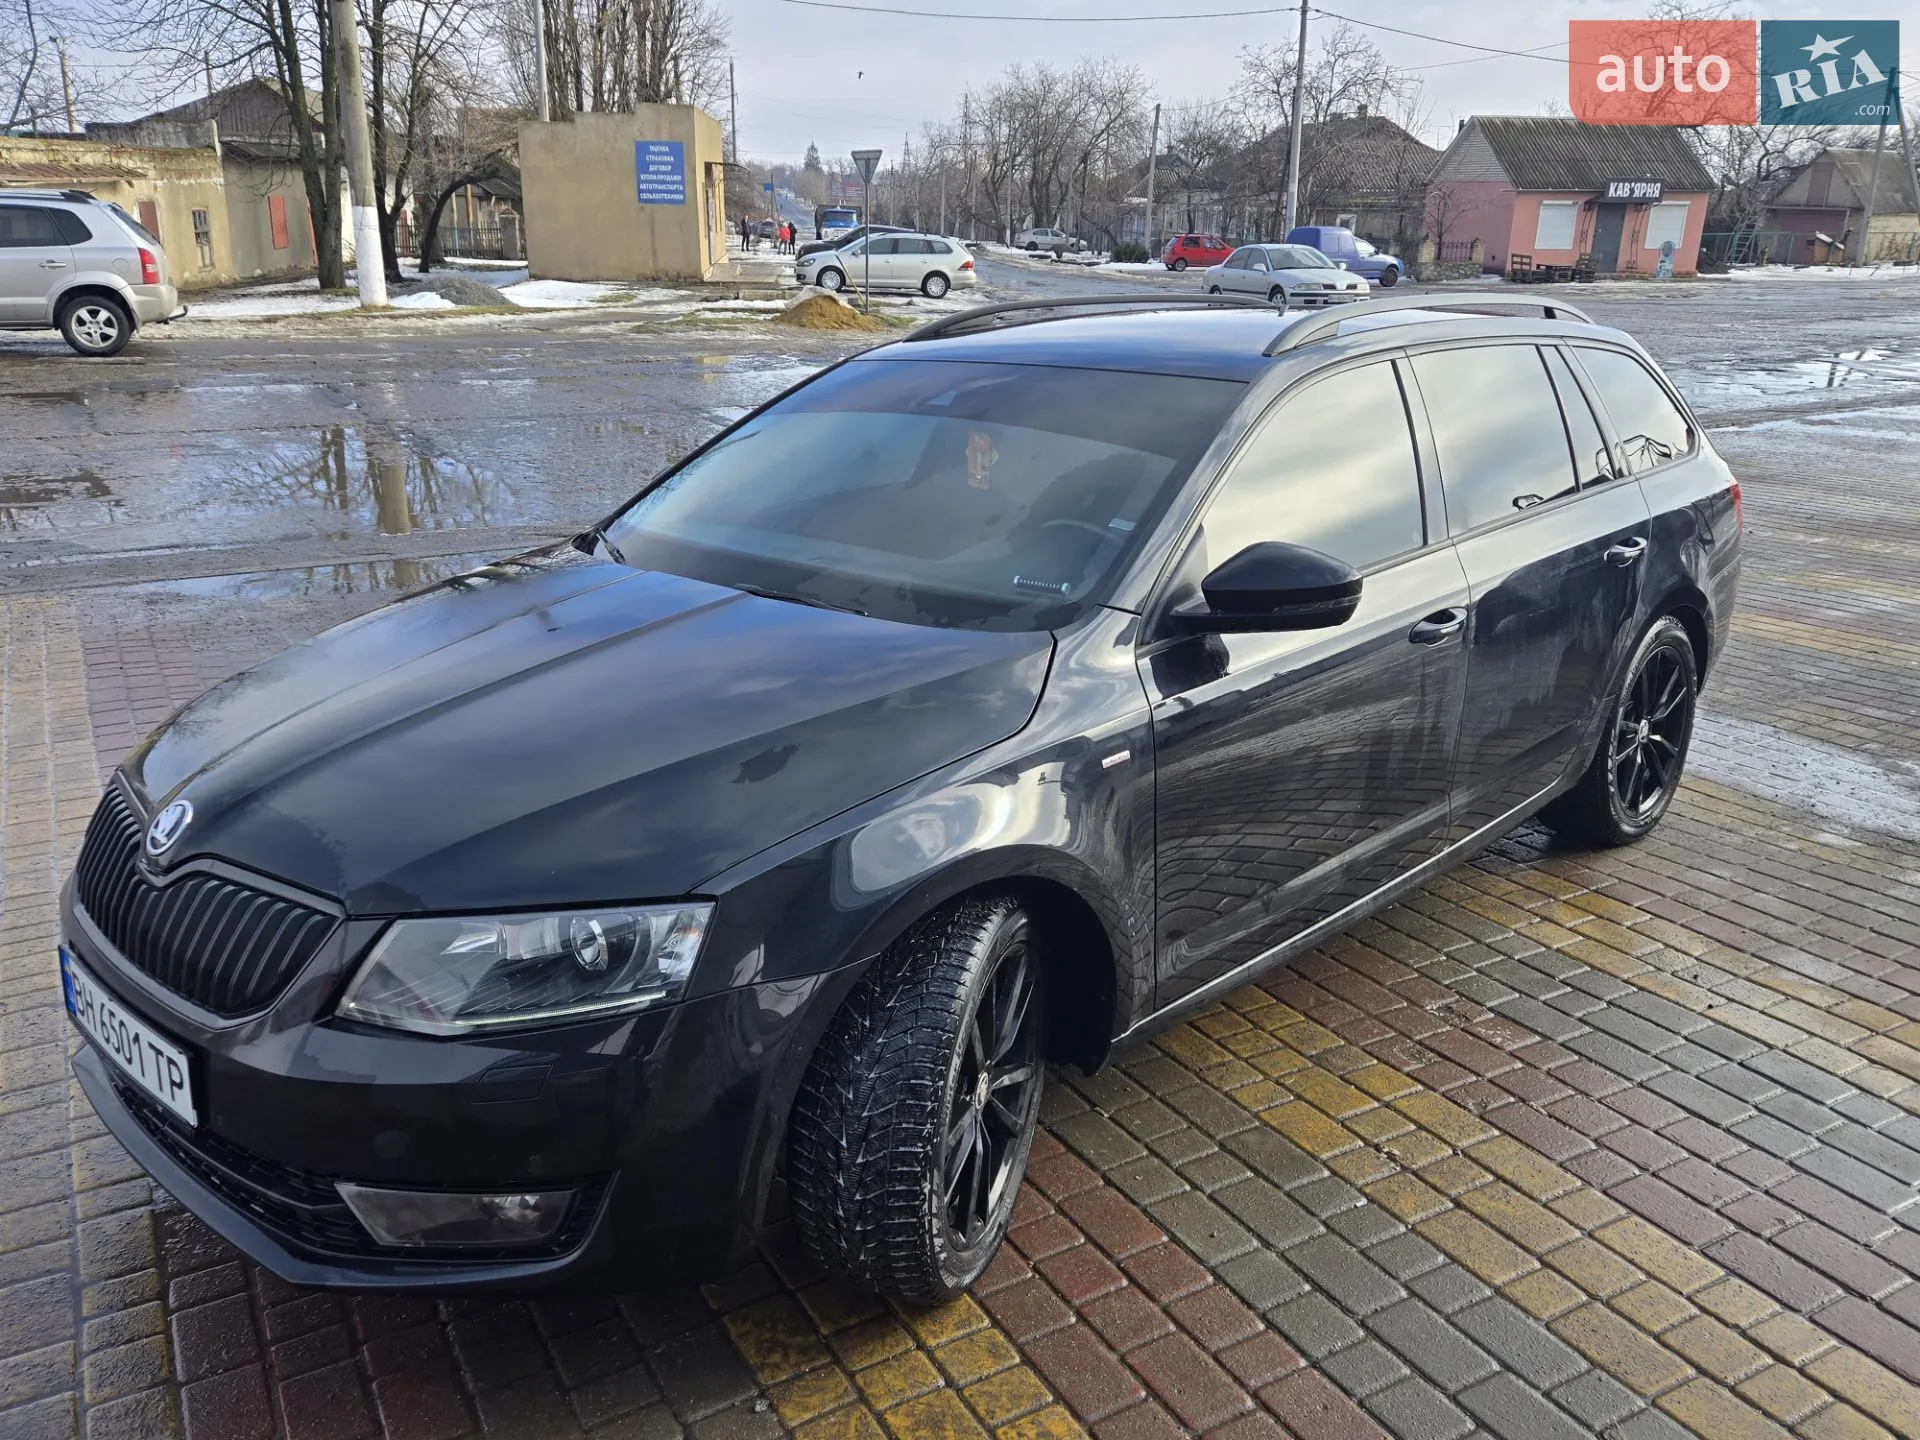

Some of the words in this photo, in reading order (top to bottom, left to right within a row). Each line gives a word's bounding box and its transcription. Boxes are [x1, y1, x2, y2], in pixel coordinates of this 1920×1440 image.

[640, 183, 683, 191] АВТОТРАНСПОРТА
[1608, 182, 1661, 198] КАВ'ЯРНЯ
[72, 972, 98, 1033] BH
[100, 1002, 145, 1078] 6501
[147, 1041, 184, 1102] TP
